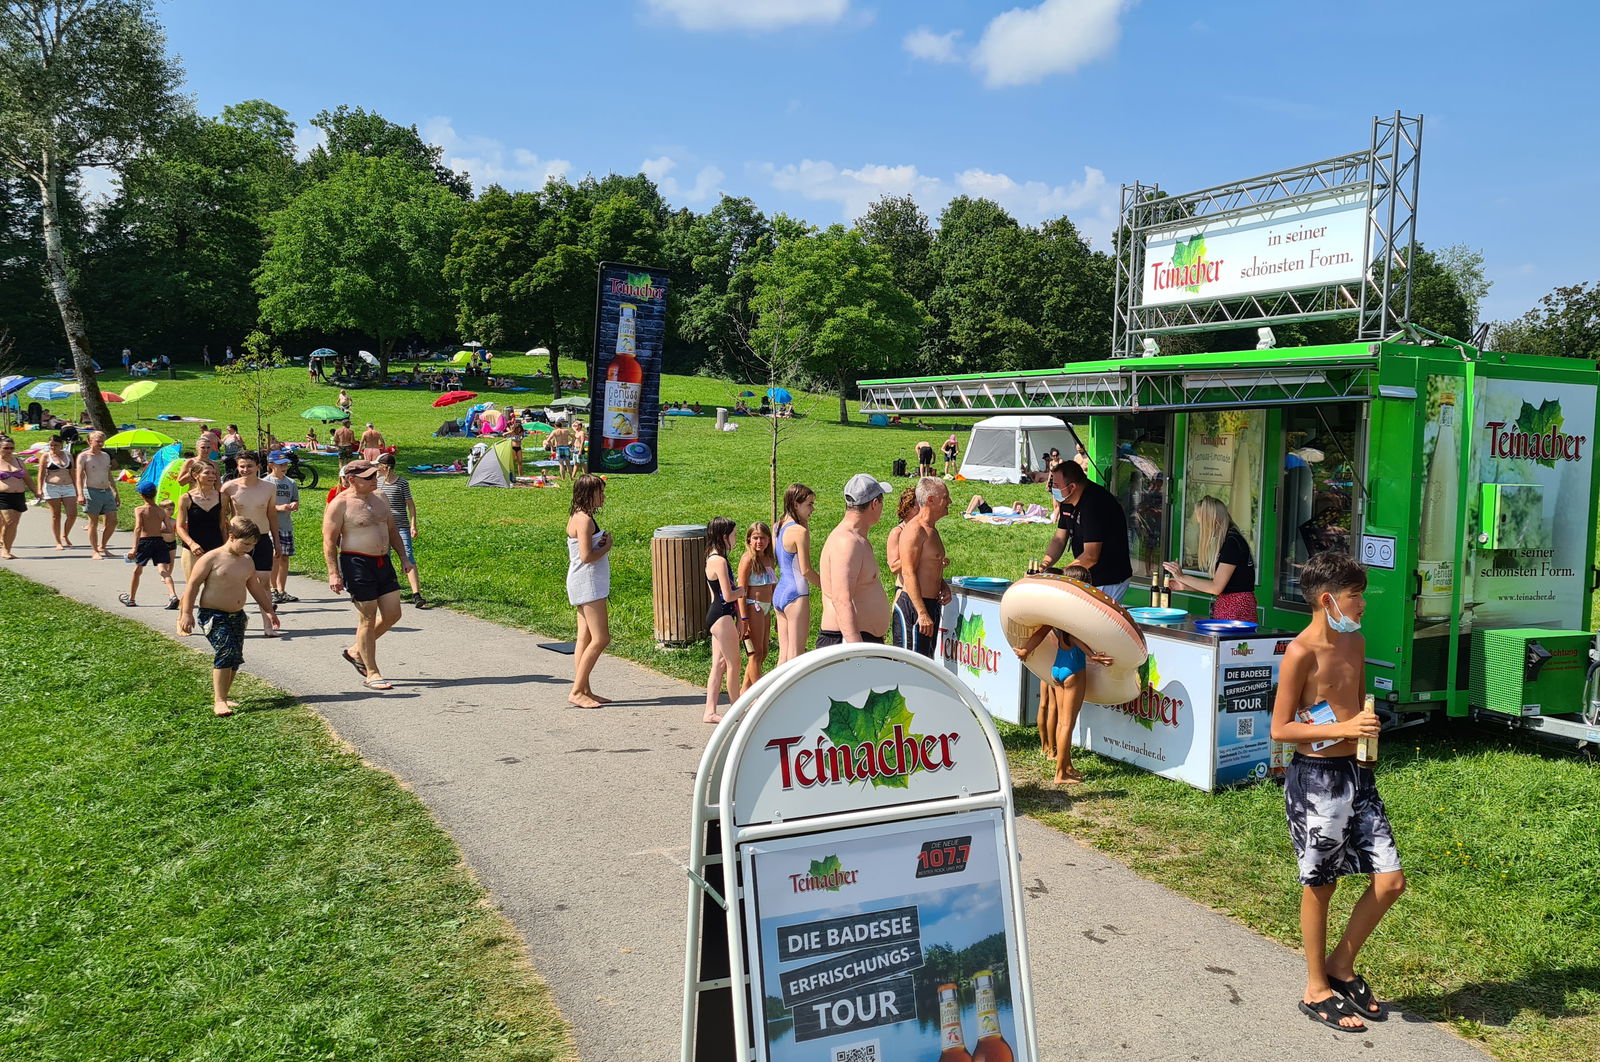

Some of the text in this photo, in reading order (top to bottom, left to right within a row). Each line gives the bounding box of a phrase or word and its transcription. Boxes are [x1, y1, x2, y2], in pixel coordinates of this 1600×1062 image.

[1267, 225, 1328, 246] in seiner
[1151, 255, 1225, 291] Teinacher
[1240, 248, 1354, 279] schönsten Form.
[608, 278, 665, 299] Teinacher
[608, 386, 638, 400] Genuss
[608, 398, 638, 408] Eistee
[1485, 421, 1587, 462] Teinacher
[1520, 549, 1555, 558] seiner
[1540, 561, 1575, 577] Form.
[938, 627, 1002, 674] Teinacher
[1227, 670, 1270, 679] DIE BADESEE
[1226, 681, 1270, 696] ERFRISCHUNGS-
[1232, 698, 1262, 711] TOUR
[764, 724, 960, 791] Teinacher
[1103, 736, 1167, 762] www.teinacher.de
[917, 845, 971, 869] 107.7
[931, 841, 942, 849] DIE
[788, 868, 859, 894] Teinacher
[787, 916, 913, 954] DIE BADESEE
[789, 947, 916, 996] ERFRISCHUNGS-
[812, 990, 900, 1030] TOUR
